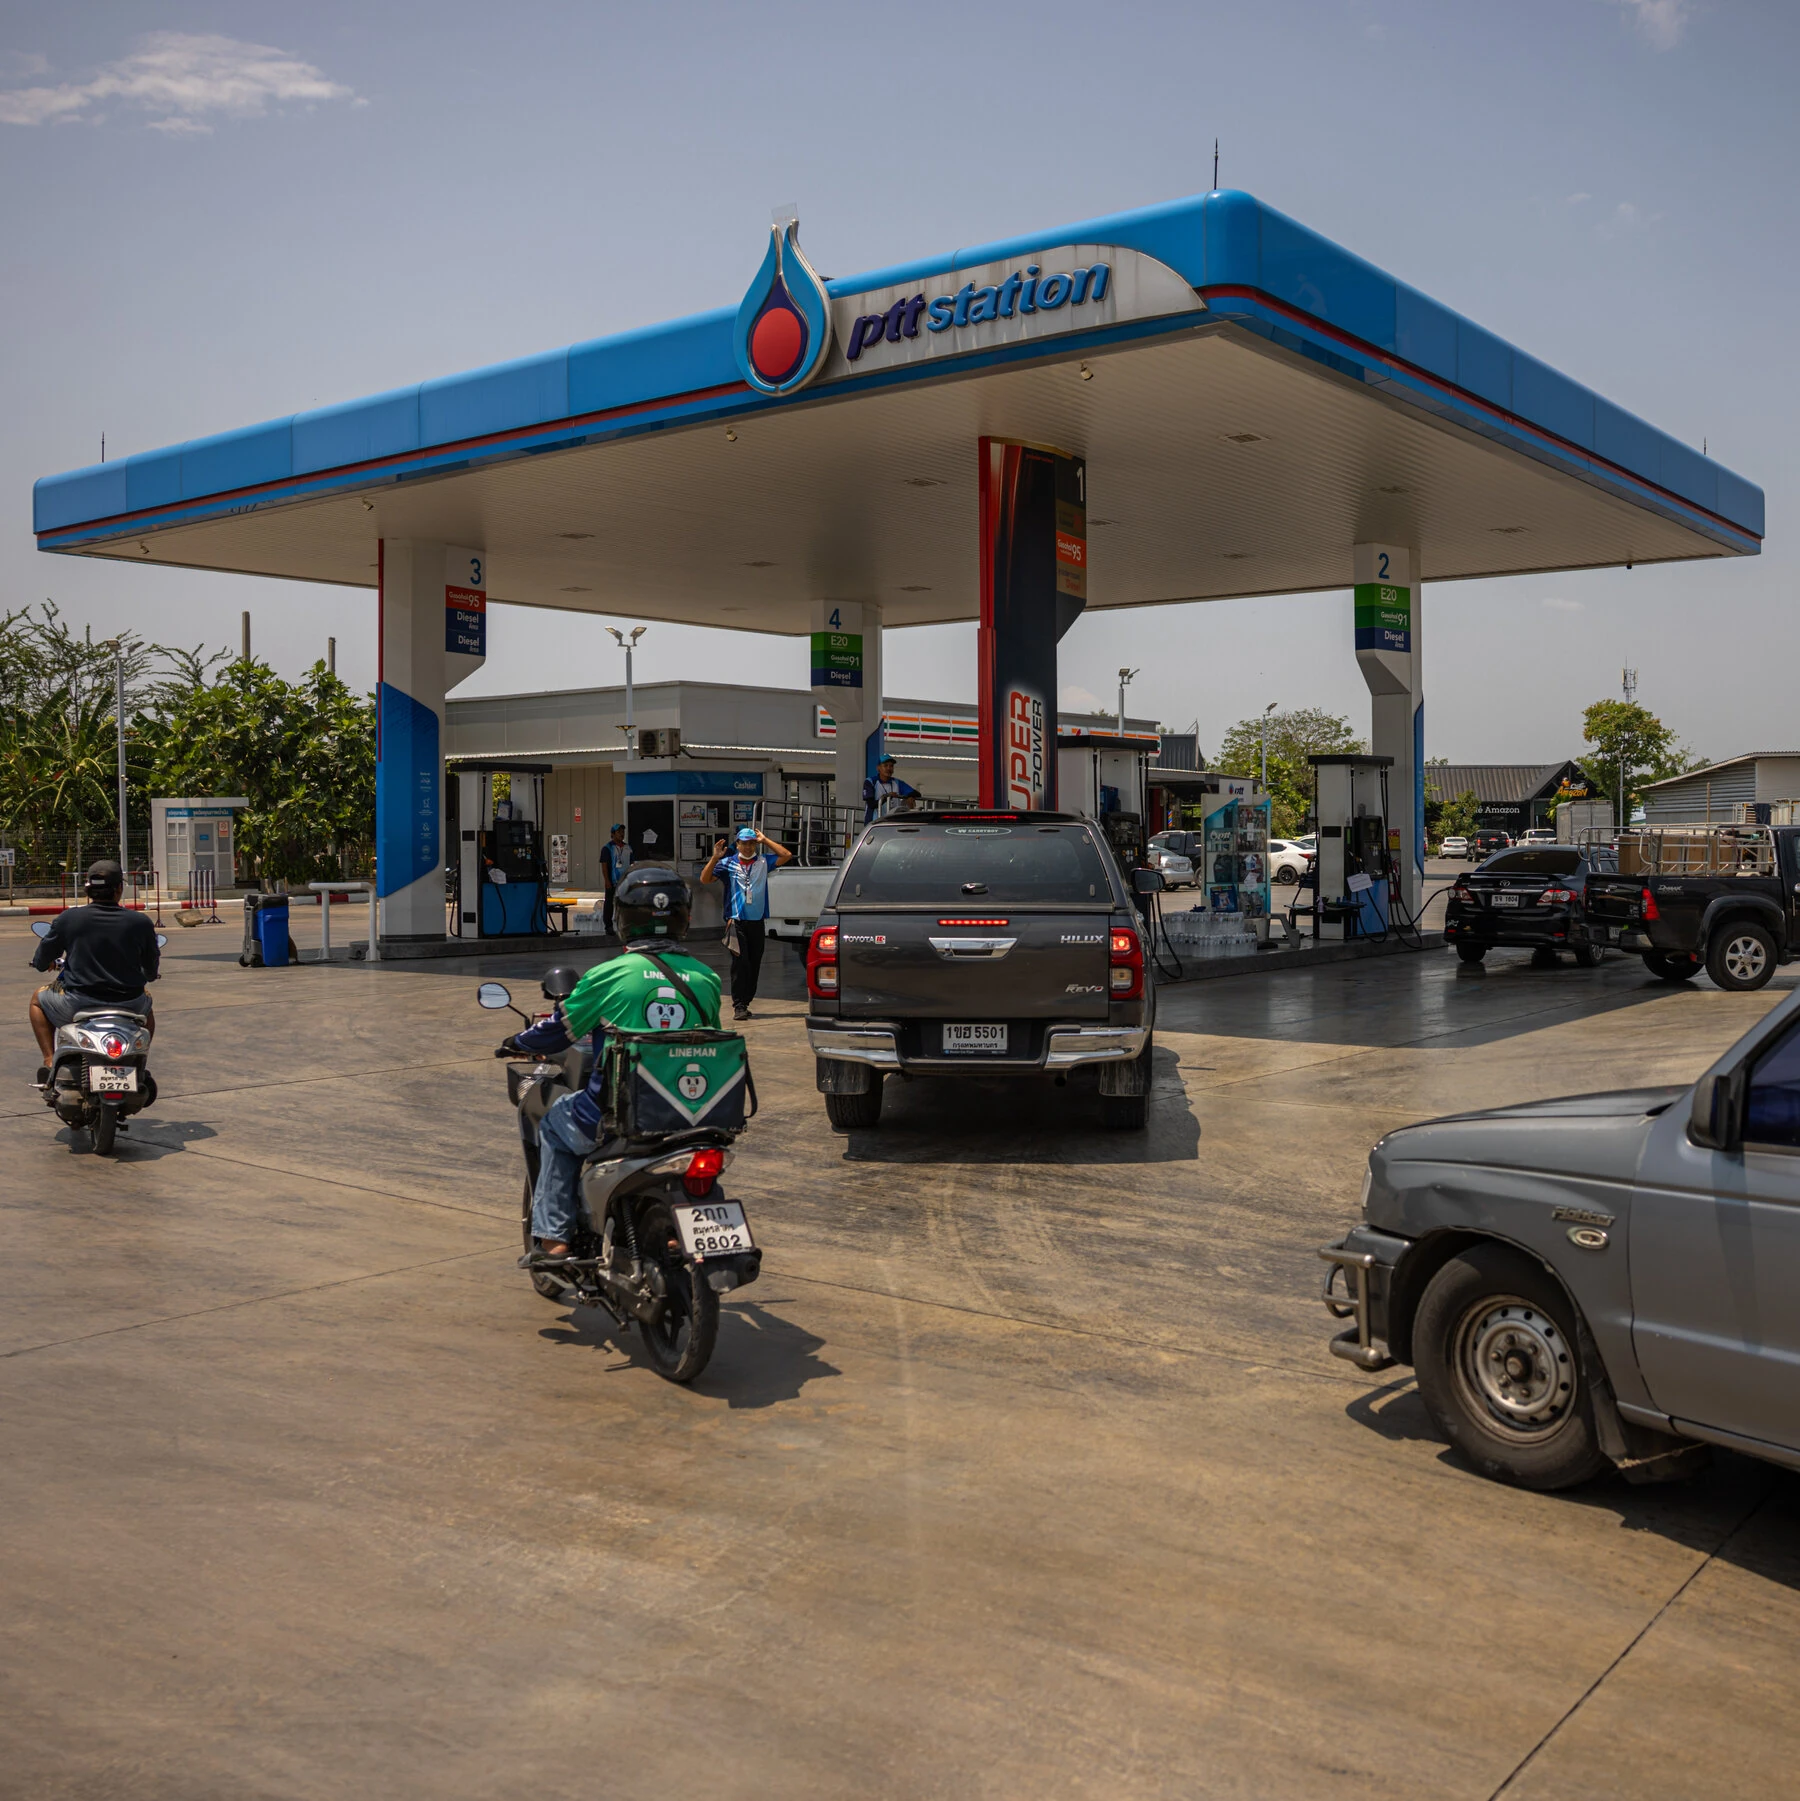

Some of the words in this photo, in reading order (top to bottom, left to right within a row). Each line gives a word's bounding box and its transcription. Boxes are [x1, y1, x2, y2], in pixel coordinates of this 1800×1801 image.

[846, 292, 927, 361] ptt
[926, 263, 1111, 334] station
[1076, 466, 1084, 502] 1
[1072, 544, 1082, 561] 95
[470, 558, 482, 585] 3
[1378, 552, 1390, 579] 2
[468, 594, 480, 608] 95
[1380, 587, 1397, 602] E20
[456, 611, 479, 623] Diesel
[828, 608, 842, 630] 4
[1397, 613, 1407, 626] 91
[458, 635, 480, 646] Diesel
[830, 635, 848, 647] E20
[1384, 630, 1404, 642] Diesel
[849, 656, 859, 667] 91
[830, 671, 851, 680] Diesel
[1032, 699, 1042, 792] POWER
[733, 781, 757, 789] Cashier
[1484, 806, 1520, 814] Amazon
[843, 935, 874, 943] TOYOTA
[1060, 935, 1104, 944] HILUX
[974, 1026, 1004, 1039] 5501
[694, 1234, 742, 1251] 6802
